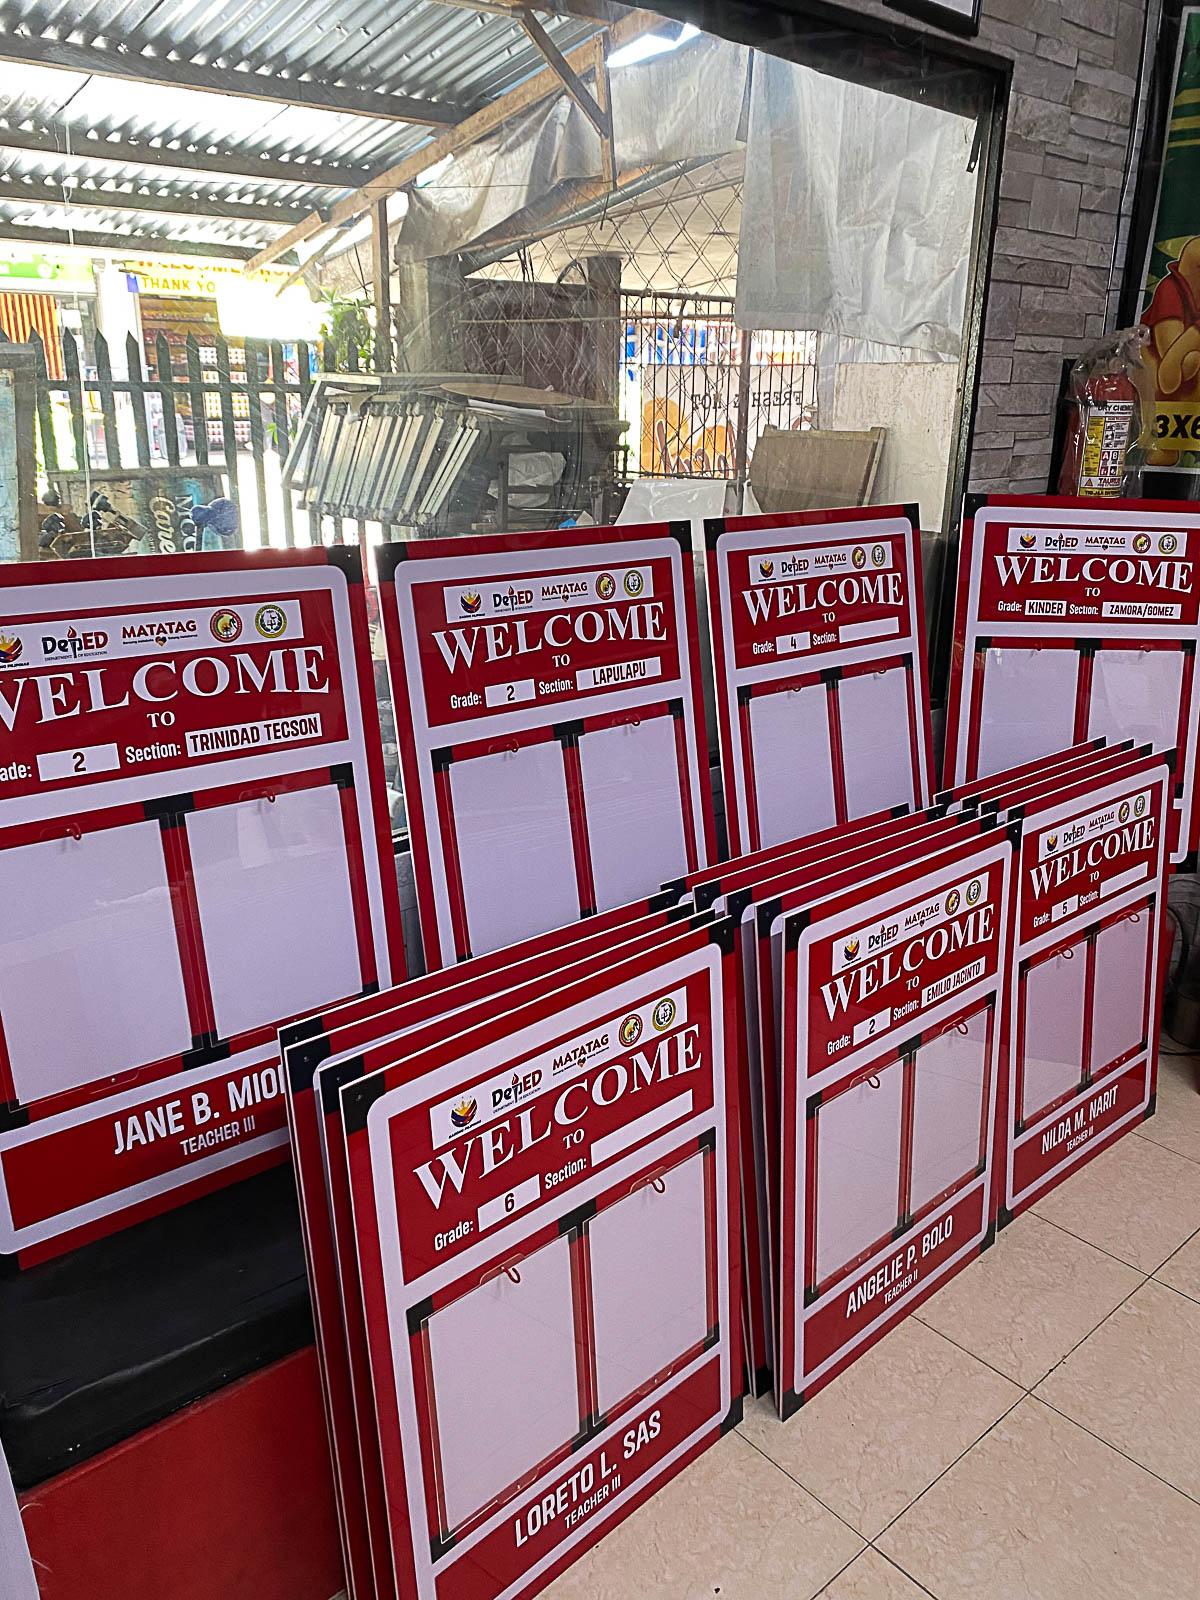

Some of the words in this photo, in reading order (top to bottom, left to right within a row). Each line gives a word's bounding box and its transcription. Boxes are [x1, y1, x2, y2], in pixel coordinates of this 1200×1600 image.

[141, 276, 191, 291] THANK
[1045, 532, 1079, 551] DepED
[1085, 536, 1126, 545] MATATAG
[781, 555, 809, 577] DepED
[814, 553, 847, 565] MATATAG
[994, 555, 1193, 594] WELCOME
[493, 588, 533, 612] DepED
[541, 581, 588, 597] MATATAG
[741, 572, 904, 626] WELCOME
[1085, 587, 1101, 597] TO
[822, 611, 836, 623] TO
[998, 601, 1022, 612] Grade:
[1028, 602, 1063, 615] KINDER
[1069, 604, 1099, 615] Section:
[1109, 603, 1174, 617] ZAMORA/GOMEZ
[41, 628, 109, 659] DepED
[121, 618, 197, 639] MATATAG
[432, 602, 667, 674] WELCOME
[752, 642, 775, 655] Grade:
[790, 636, 797, 650] 4
[812, 632, 837, 646] Section:
[552, 654, 570, 668] TO
[451, 691, 482, 709] Grade:
[506, 684, 516, 702] 2
[539, 678, 574, 695] Section:
[592, 661, 646, 686] LAPULAPU
[146, 711, 175, 729] TO
[72, 752, 87, 773] 2
[126, 743, 182, 764] Section:
[189, 726, 260, 753] TRINIDAD
[264, 717, 319, 740] TECSON
[1089, 811, 1114, 829] MATATAG
[1030, 817, 1155, 900] WELCOME
[1089, 870, 1100, 883] TO
[904, 902, 940, 927] MATATAG
[1033, 912, 1050, 928] Grade:
[1062, 901, 1068, 915] 5
[1079, 890, 1099, 907] Section:
[868, 923, 899, 949] DepED
[820, 903, 994, 1022] WELCOME
[906, 975, 920, 991] TO
[827, 1035, 850, 1056] Grade:
[868, 1018, 876, 1035] 2
[893, 1000, 919, 1021] Section:
[926, 979, 951, 1003] EMILIO
[952, 961, 981, 989] JACINTO
[552, 1033, 609, 1071] MATATAG
[491, 1070, 543, 1104] DepED
[114, 1100, 185, 1155] JANE
[191, 1092, 220, 1125] B.
[413, 1023, 702, 1210] WELCOME
[1042, 1117, 1071, 1155] NILDA
[1074, 1108, 1086, 1132] M.
[1089, 1085, 1118, 1121] NARIT
[180, 1122, 240, 1156] TEACHER
[243, 1115, 256, 1132] III
[563, 1128, 585, 1150] TO
[434, 1220, 474, 1251] Grade:
[504, 1192, 515, 1213] 6
[544, 1158, 587, 1190] Section:
[846, 1253, 903, 1318] ANGELIE
[906, 1245, 918, 1270] P.
[922, 1215, 953, 1258] BOLO
[884, 1273, 912, 1305] TEACHER
[913, 1269, 918, 1281] II
[515, 1463, 594, 1547] LORETO
[600, 1451, 617, 1479] L.
[623, 1410, 661, 1459] SAS
[565, 1484, 609, 1529] TEACHER
[611, 1474, 621, 1492] III
